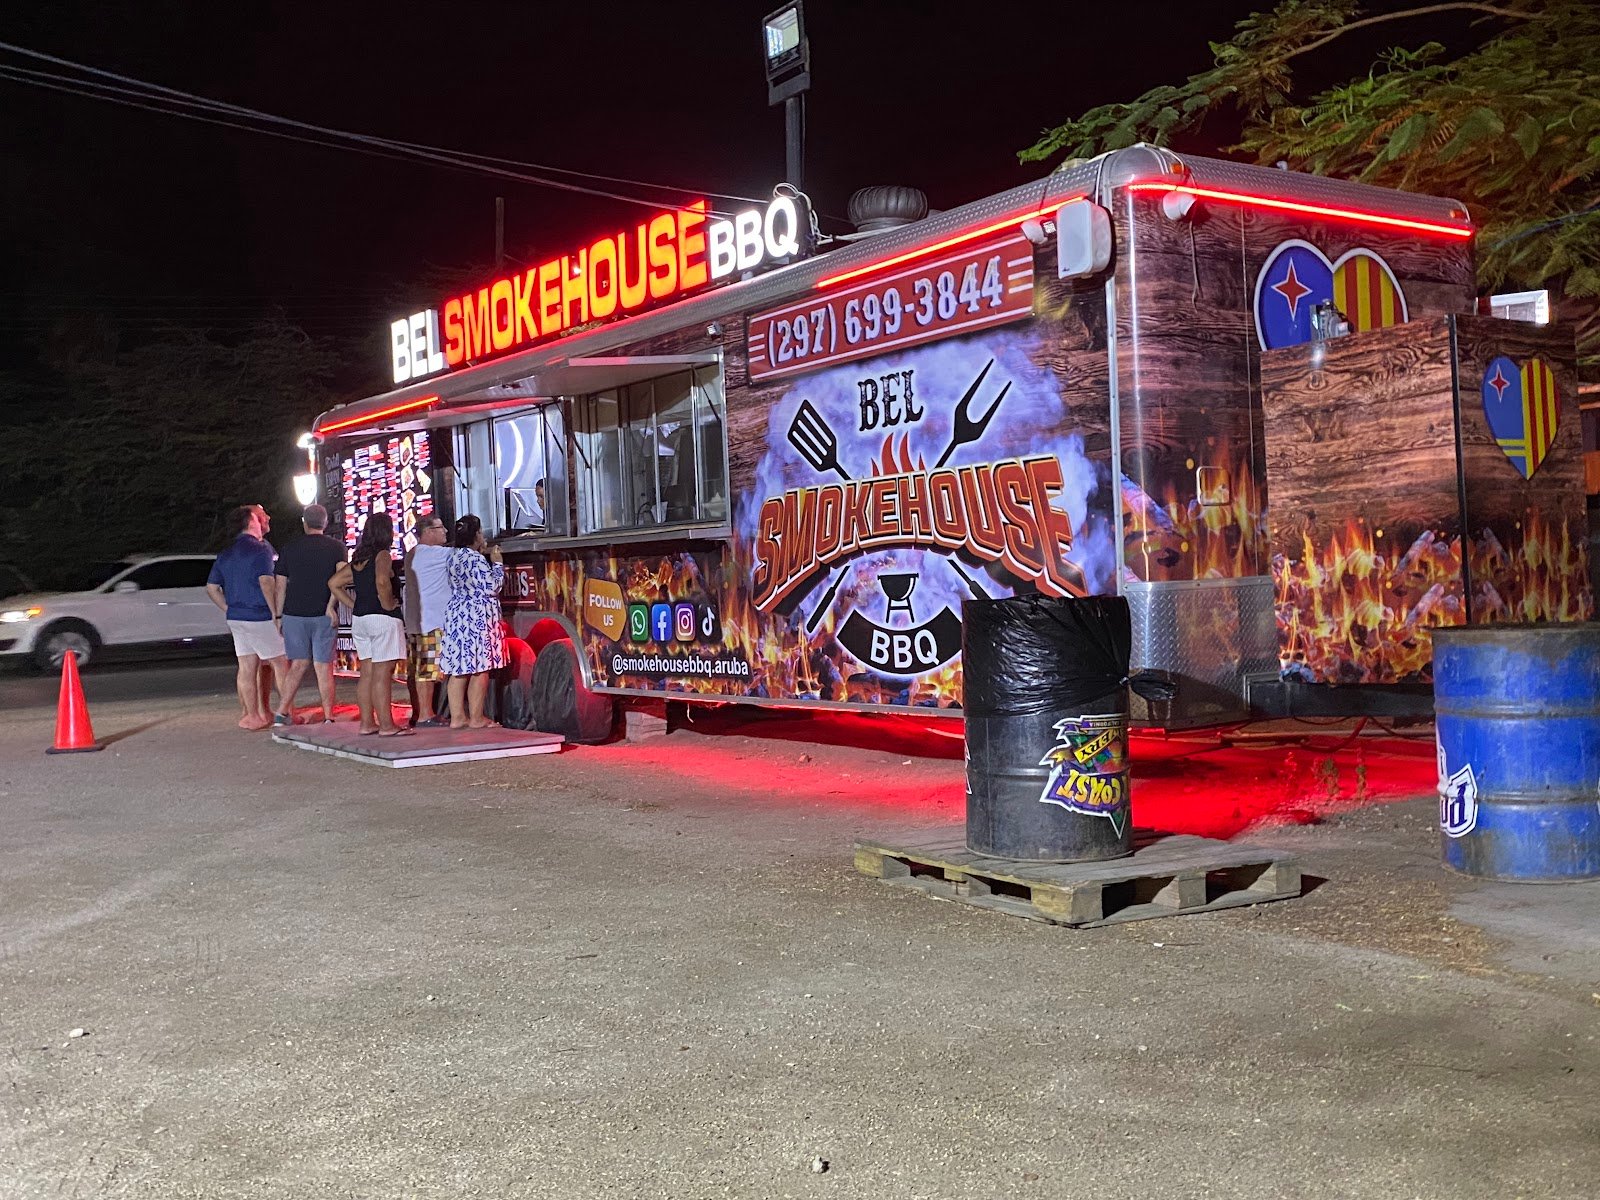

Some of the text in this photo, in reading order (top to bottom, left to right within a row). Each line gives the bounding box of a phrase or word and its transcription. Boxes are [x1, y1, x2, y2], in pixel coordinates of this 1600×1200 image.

[391, 197, 799, 384] BEL SMOKEHOUSE BBQ
[768, 255, 1003, 368] (297) 699-3844
[857, 369, 924, 432] BEL
[753, 453, 1089, 614] SMOKEHOUSE
[589, 594, 622, 610] FOLLOW
[603, 614, 614, 627] US
[612, 654, 749, 677] @smokehousebbq.aruba
[870, 629, 940, 669] BBQ
[1056, 769, 1121, 806] COAST
